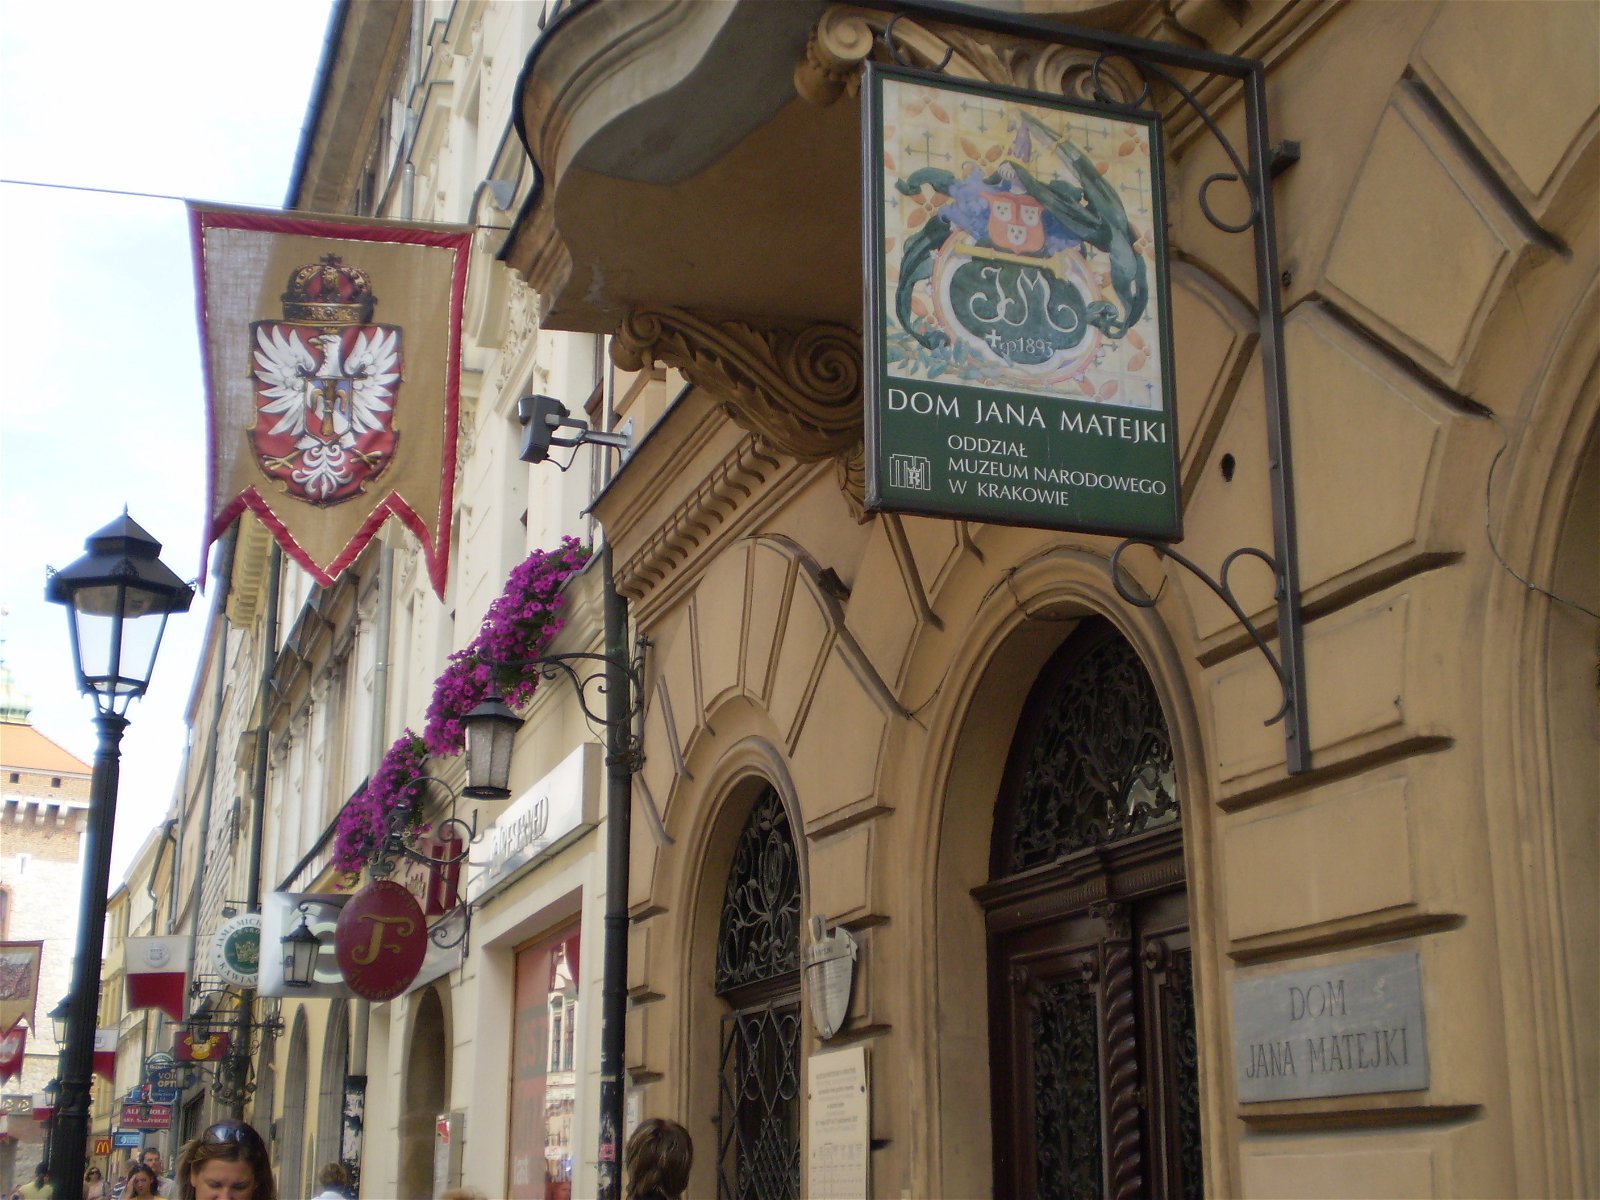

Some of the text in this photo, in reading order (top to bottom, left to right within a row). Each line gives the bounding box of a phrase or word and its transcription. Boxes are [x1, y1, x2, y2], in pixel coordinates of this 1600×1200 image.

[887, 388, 1168, 444] DOM JANA MATEJKI
[947, 434, 1028, 459] ODDZIAŁ
[948, 457, 1167, 496] MUZEUM NARODOWEGO
[948, 479, 1070, 507] W KRAKOWIE
[1289, 979, 1348, 1022] DOM
[1246, 1028, 1410, 1079] JANA MATEJKI
